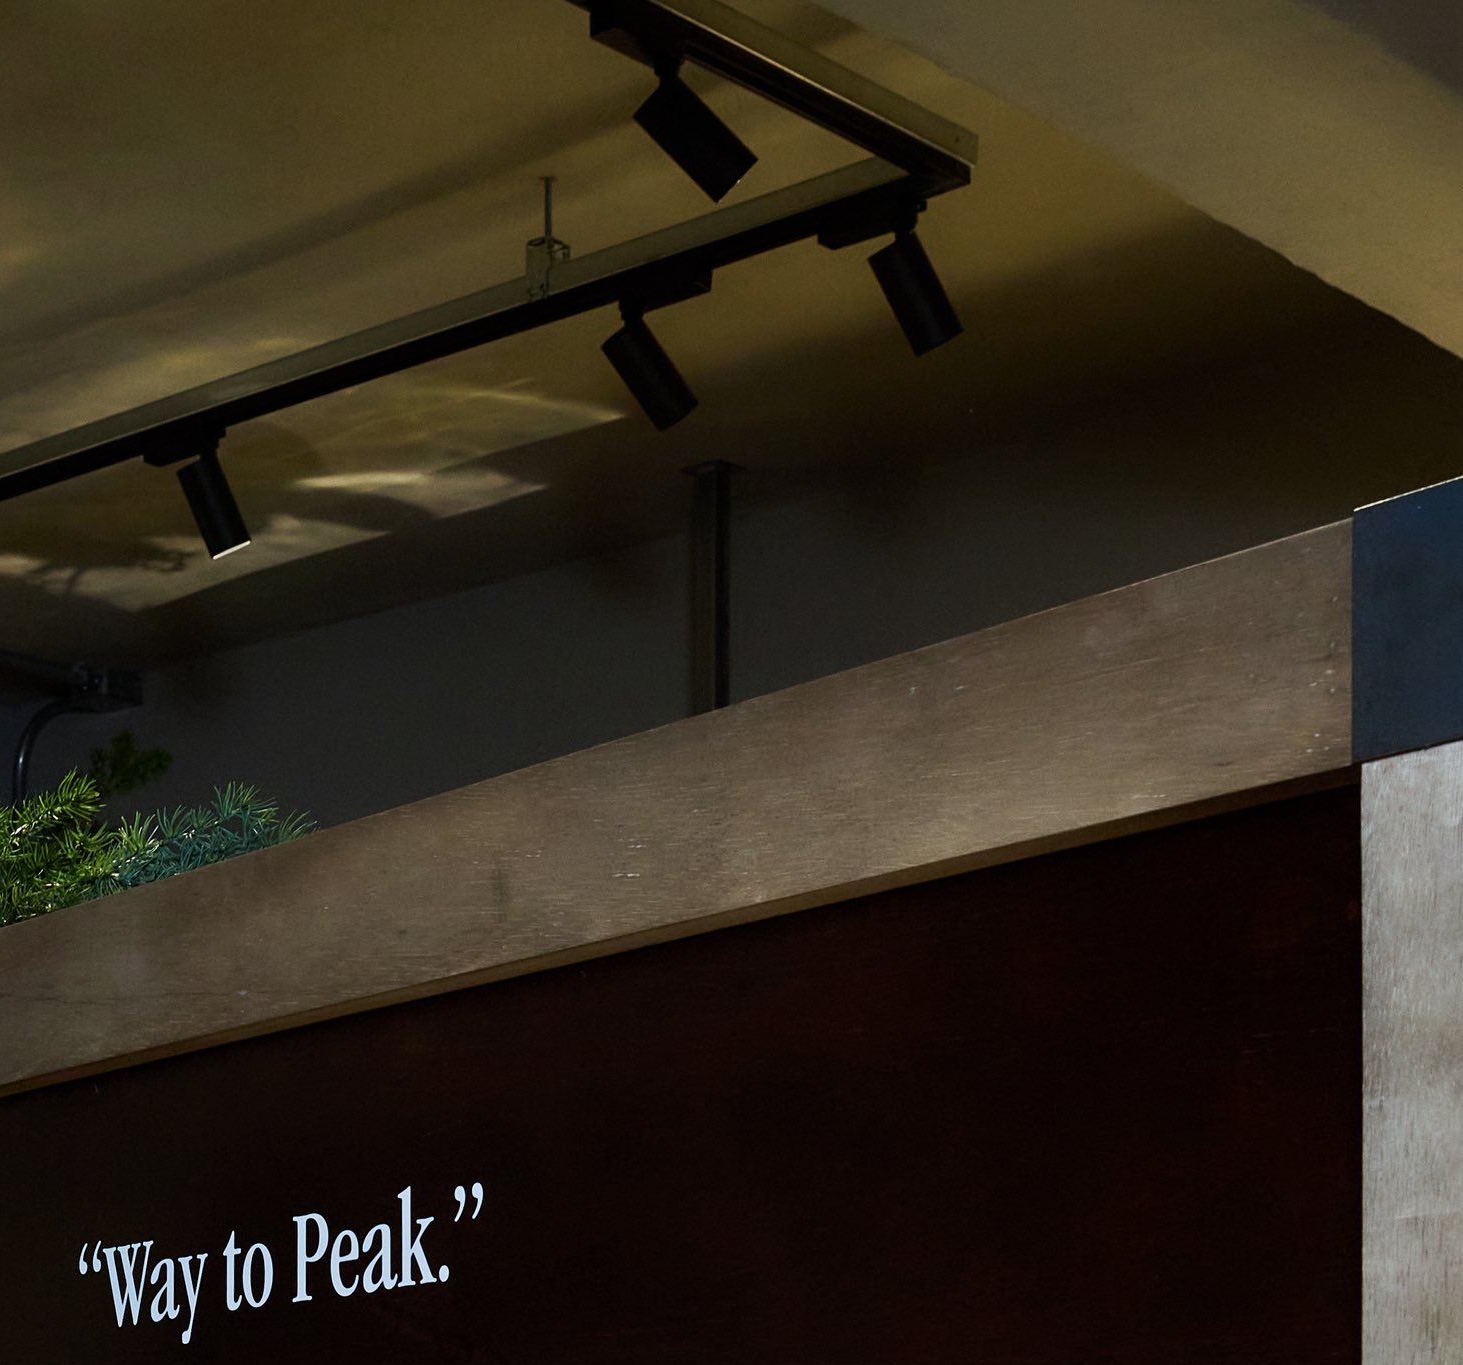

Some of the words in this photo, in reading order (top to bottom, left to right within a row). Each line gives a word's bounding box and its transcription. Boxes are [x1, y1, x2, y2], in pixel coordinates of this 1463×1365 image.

[79, 1240, 208, 1344] “Way
[223, 1231, 273, 1311] to
[292, 1182, 483, 1302] Peak.”
